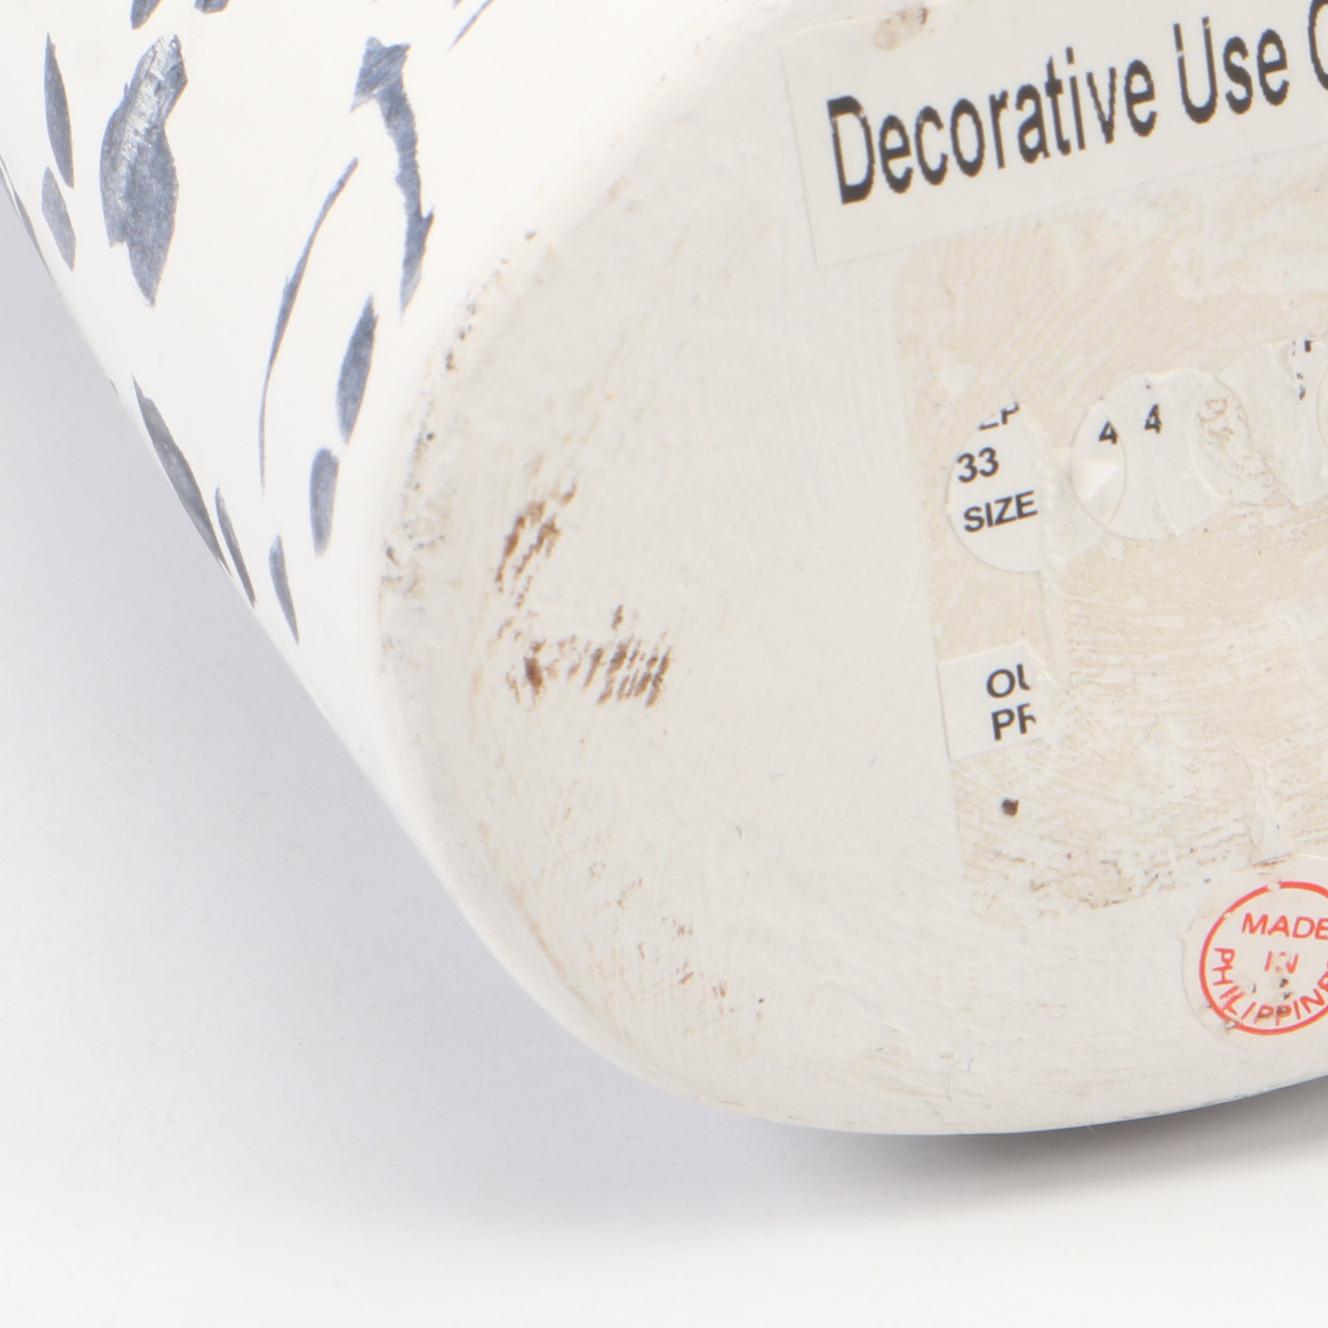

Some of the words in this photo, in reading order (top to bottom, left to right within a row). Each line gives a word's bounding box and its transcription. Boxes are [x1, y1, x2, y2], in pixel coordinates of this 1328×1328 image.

[828, 46, 1158, 204] Decorative
[1172, 16, 1290, 124] Use
[1098, 420, 1118, 445] 4
[1144, 403, 1163, 434] 4
[956, 446, 1000, 484] 33
[963, 489, 1039, 533] SIZE
[1264, 950, 1299, 974] IN
